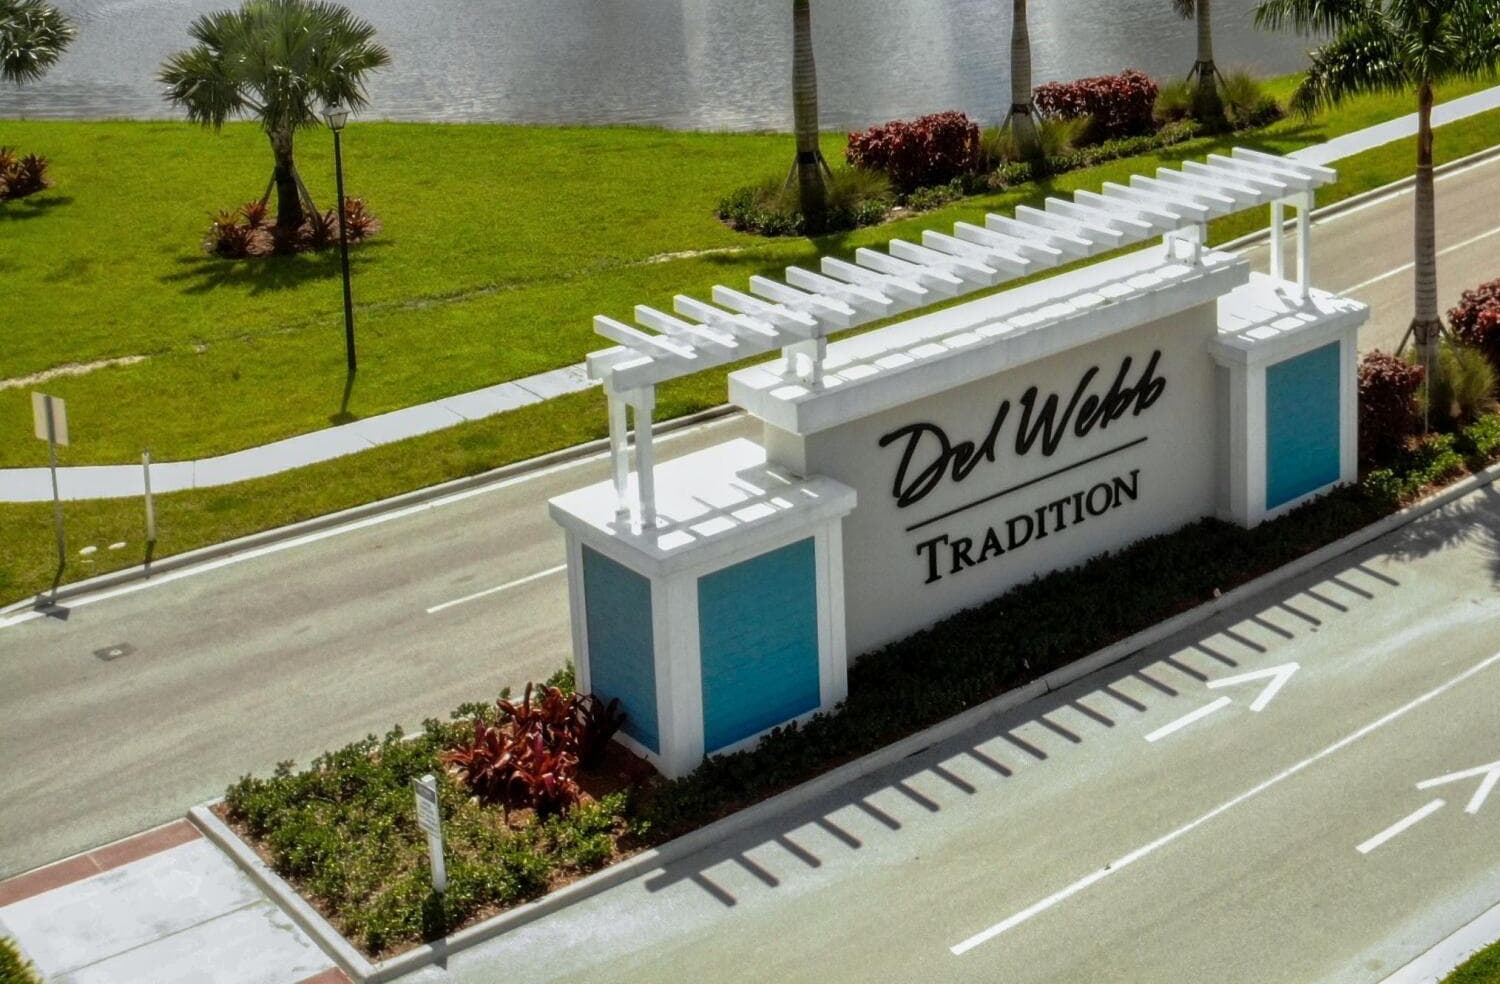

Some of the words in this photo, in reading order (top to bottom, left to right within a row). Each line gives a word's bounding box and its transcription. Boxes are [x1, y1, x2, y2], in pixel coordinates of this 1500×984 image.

[878, 400, 1010, 508] Del
[1014, 349, 1167, 457] Webb
[915, 468, 1141, 585] TRADITION
